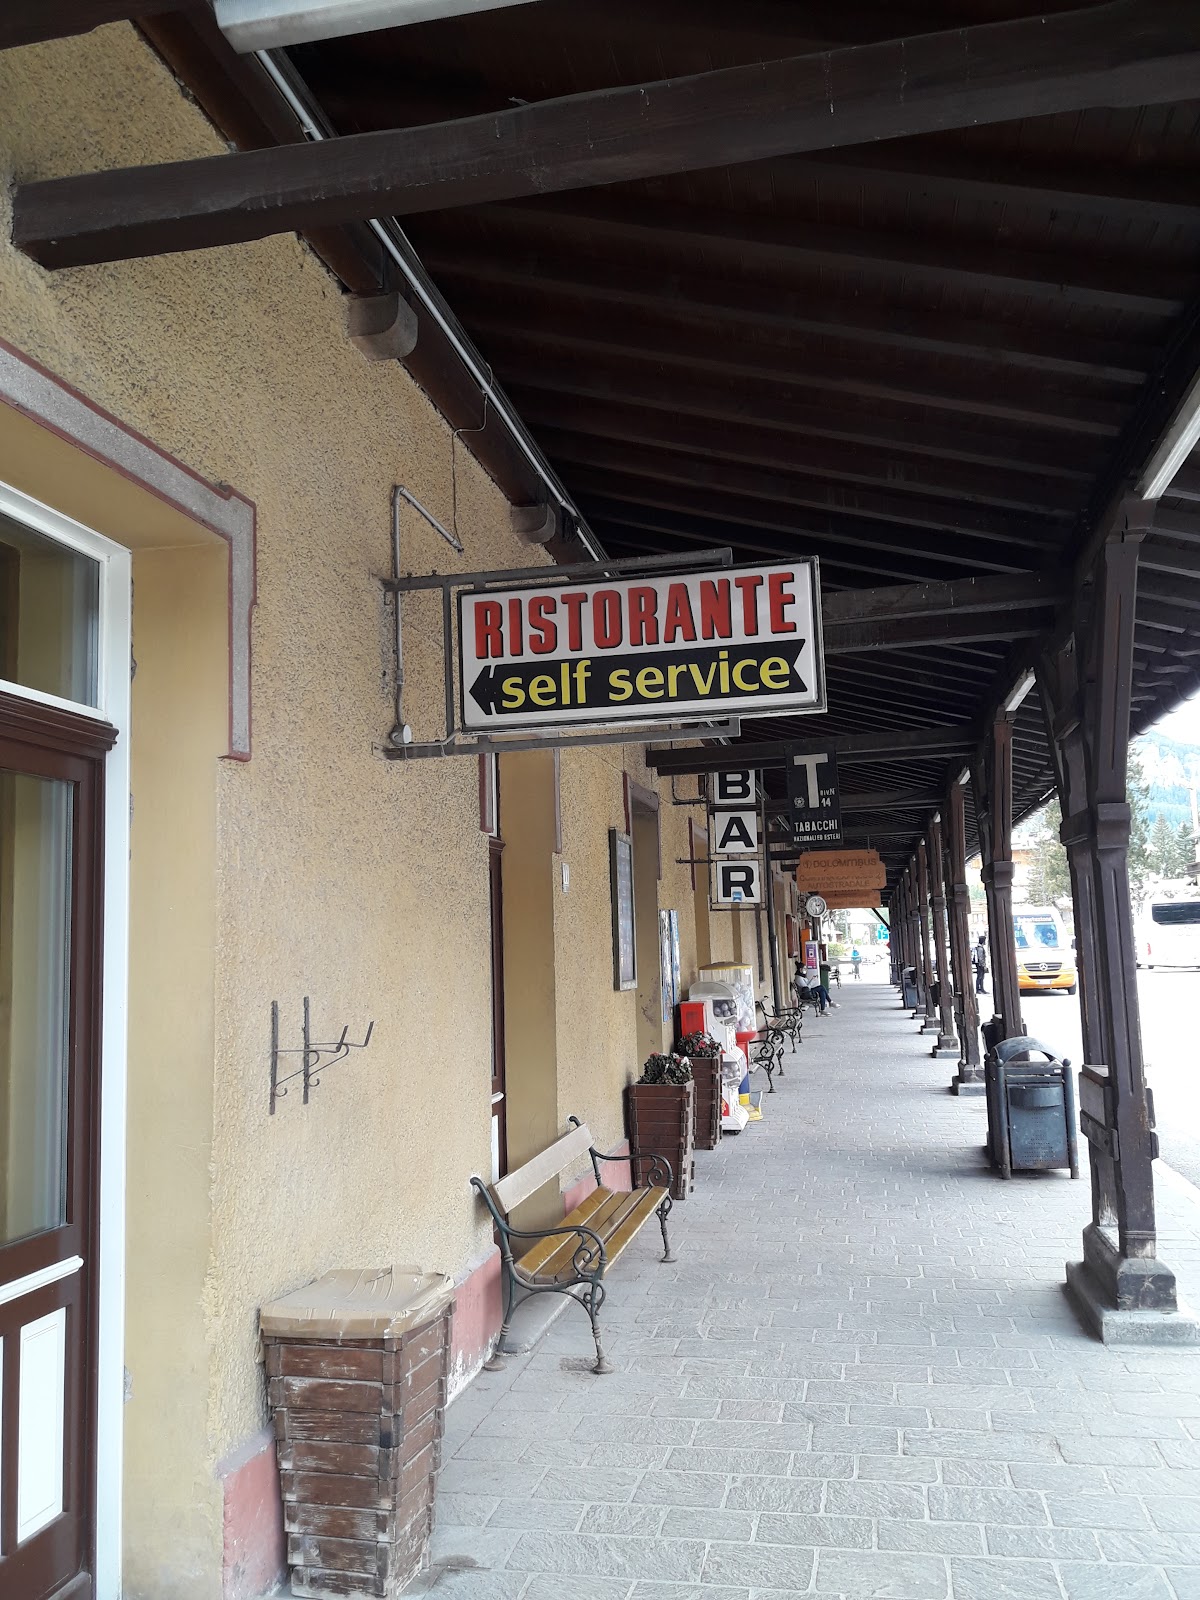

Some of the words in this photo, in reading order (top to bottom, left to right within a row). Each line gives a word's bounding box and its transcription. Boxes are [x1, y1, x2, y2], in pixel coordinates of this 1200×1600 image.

[474, 572, 796, 659] RISTORANTE
[501, 659, 591, 709] self
[608, 650, 791, 702] service
[793, 752, 829, 809] T
[821, 797, 831, 807] 14
[794, 819, 838, 833] TABACCHI
[807, 880, 870, 890] AUTOSTRADALE
